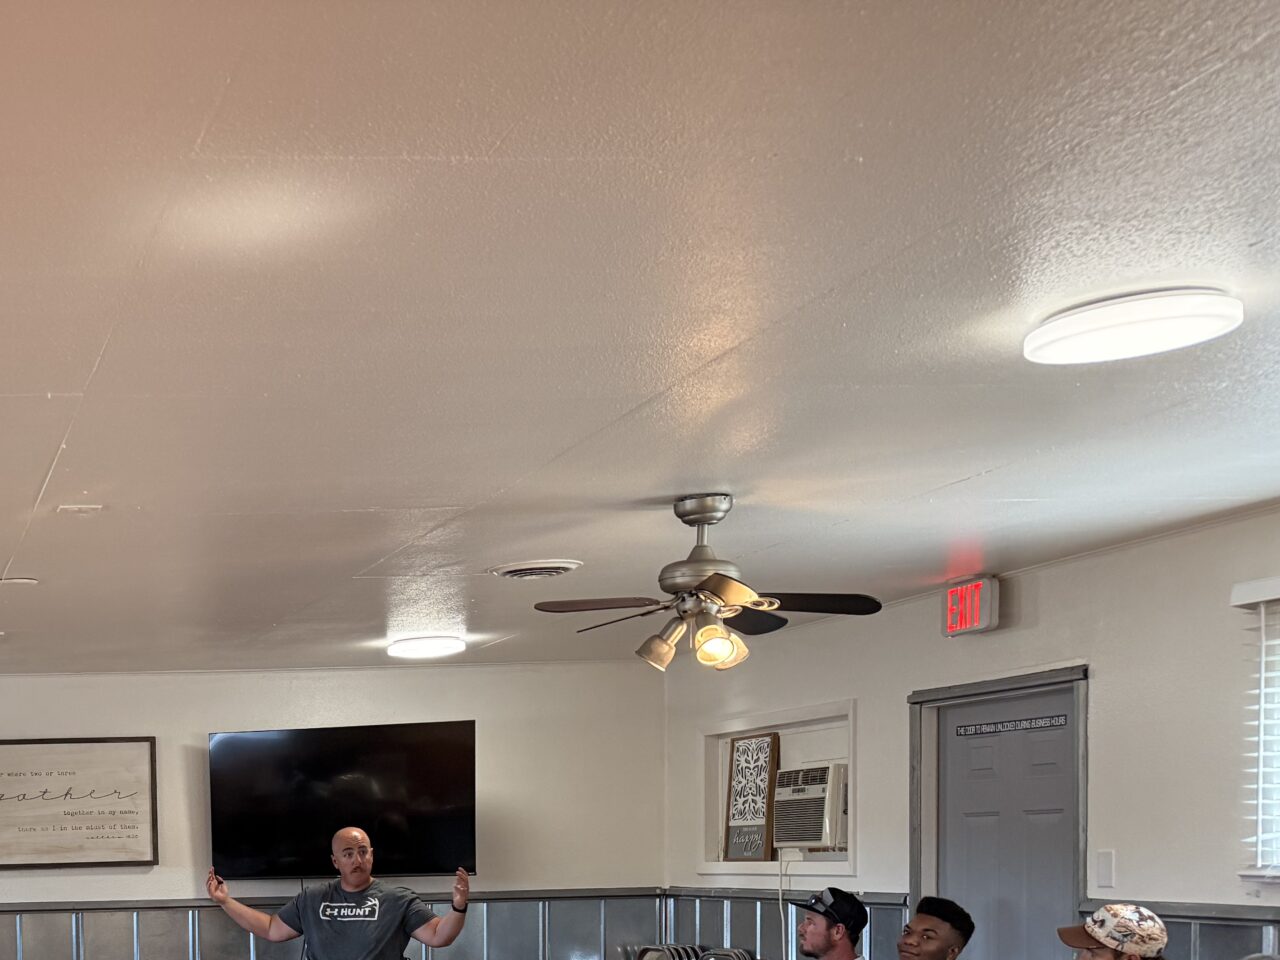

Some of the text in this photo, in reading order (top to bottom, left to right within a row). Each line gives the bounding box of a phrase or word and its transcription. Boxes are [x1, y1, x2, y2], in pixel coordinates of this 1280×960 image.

[947, 581, 983, 634] EXIT
[63, 809, 94, 817] together
[340, 907, 372, 916] HUNT
